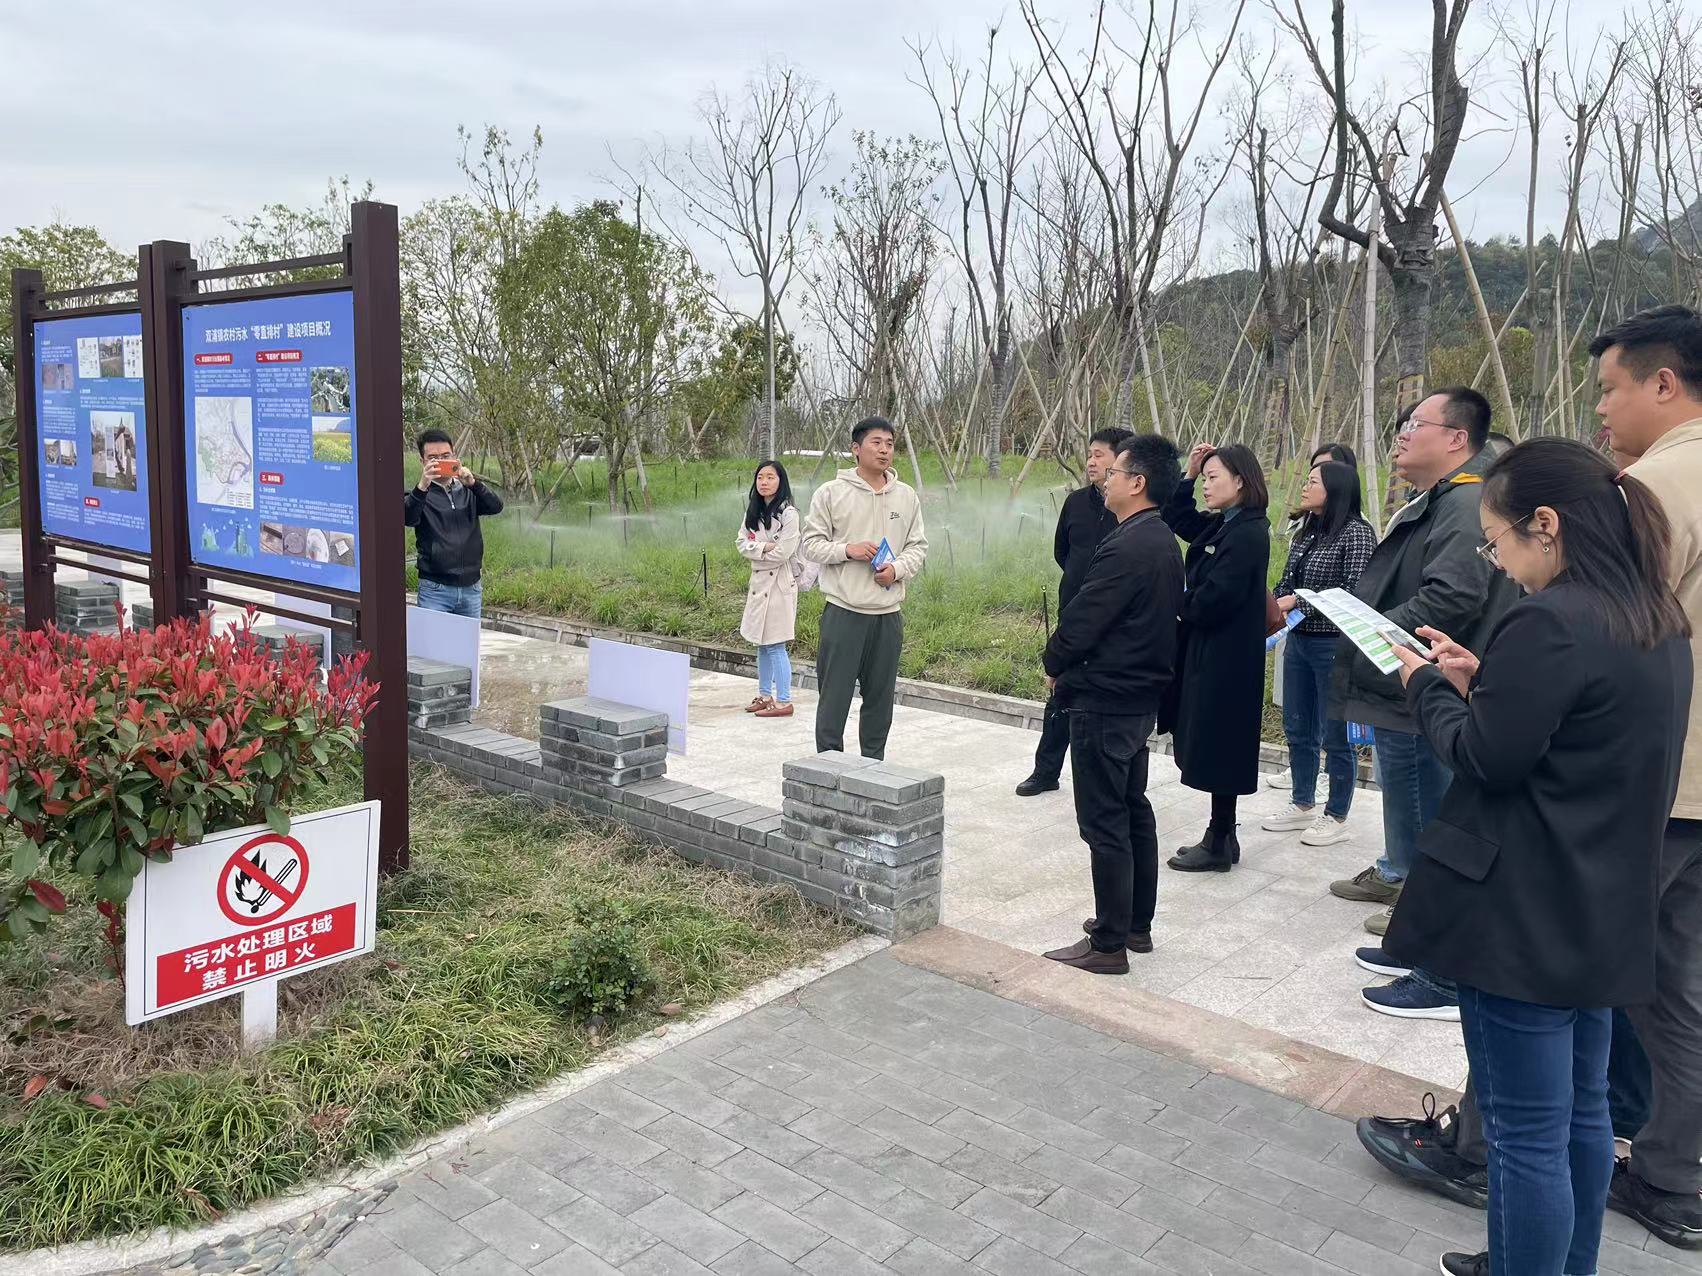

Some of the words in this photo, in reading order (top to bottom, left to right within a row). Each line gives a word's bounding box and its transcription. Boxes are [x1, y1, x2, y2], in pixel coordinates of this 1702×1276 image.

[183, 914, 333, 973] 污水处理区域
[201, 942, 316, 991] 禁止明火
